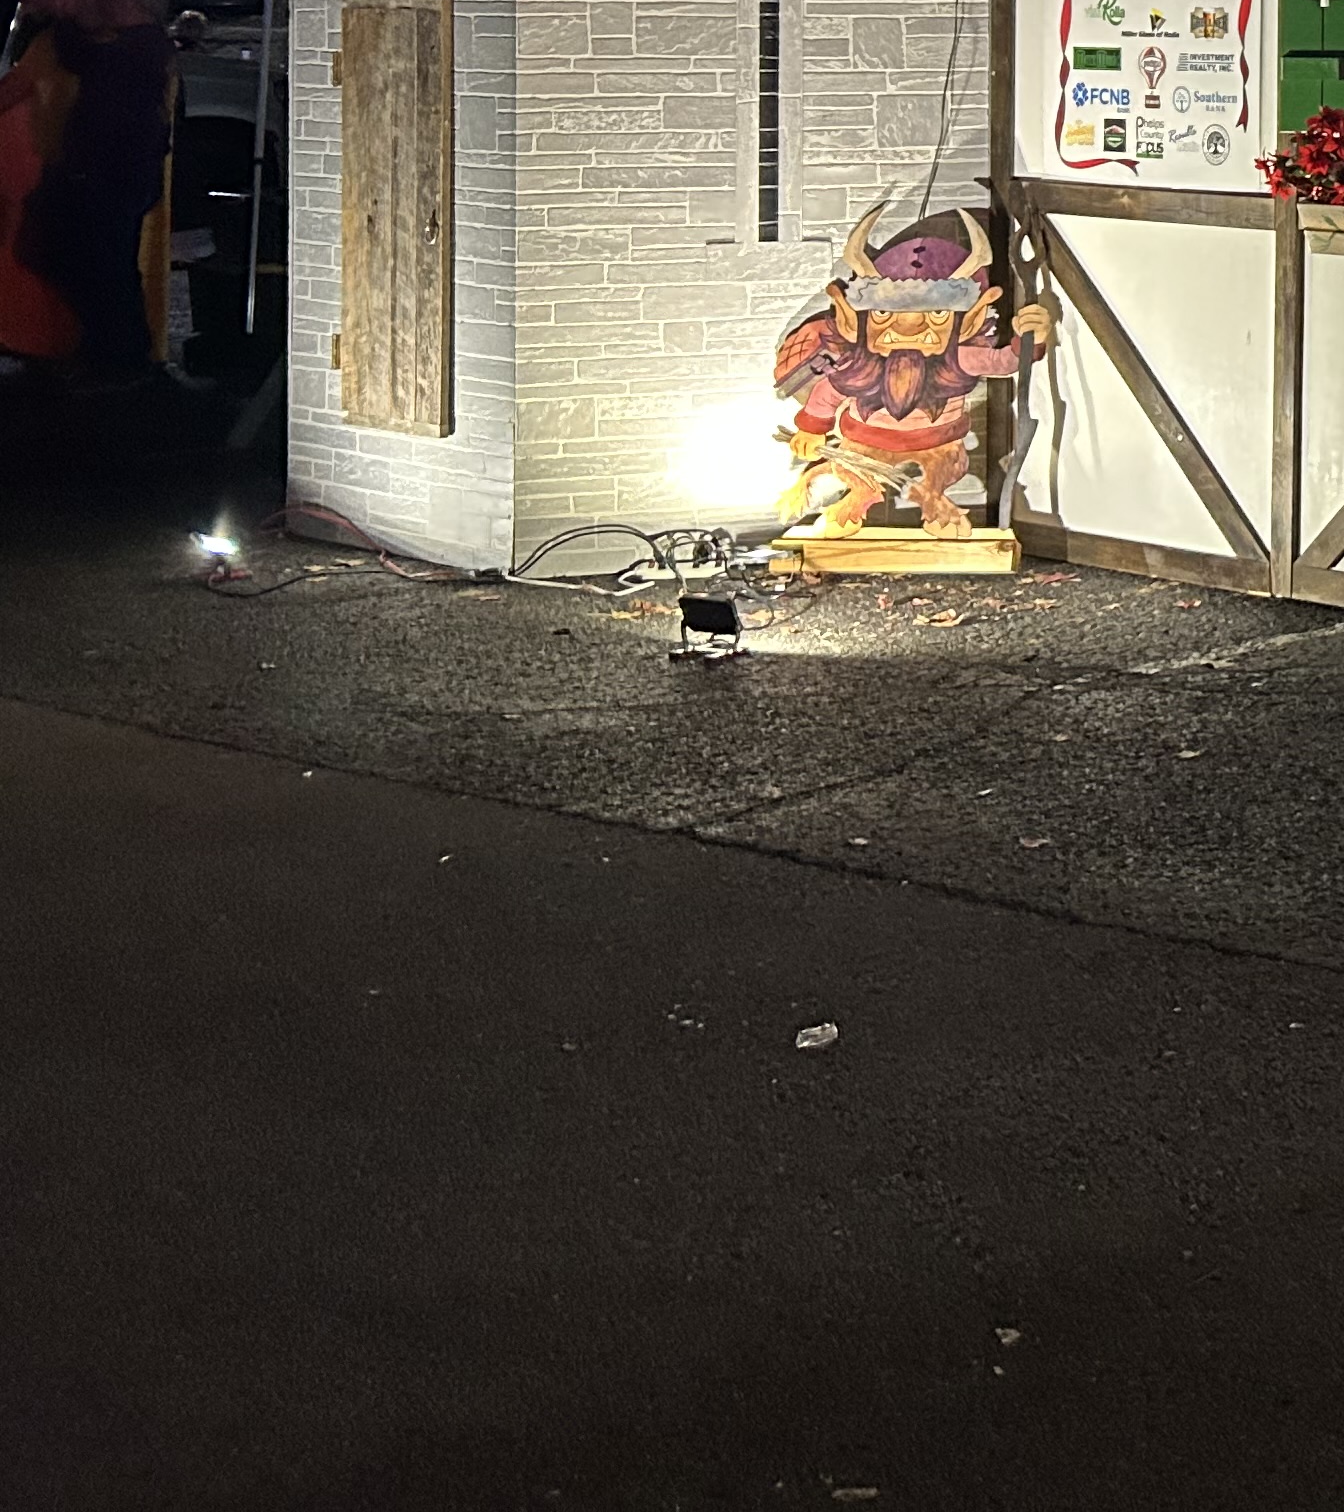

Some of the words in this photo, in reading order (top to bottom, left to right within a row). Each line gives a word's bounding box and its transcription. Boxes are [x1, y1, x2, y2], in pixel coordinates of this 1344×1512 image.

[1190, 53, 1235, 61] INVESTMENT
[1090, 88, 1130, 106] FCNB
[1194, 90, 1238, 104] Southern
